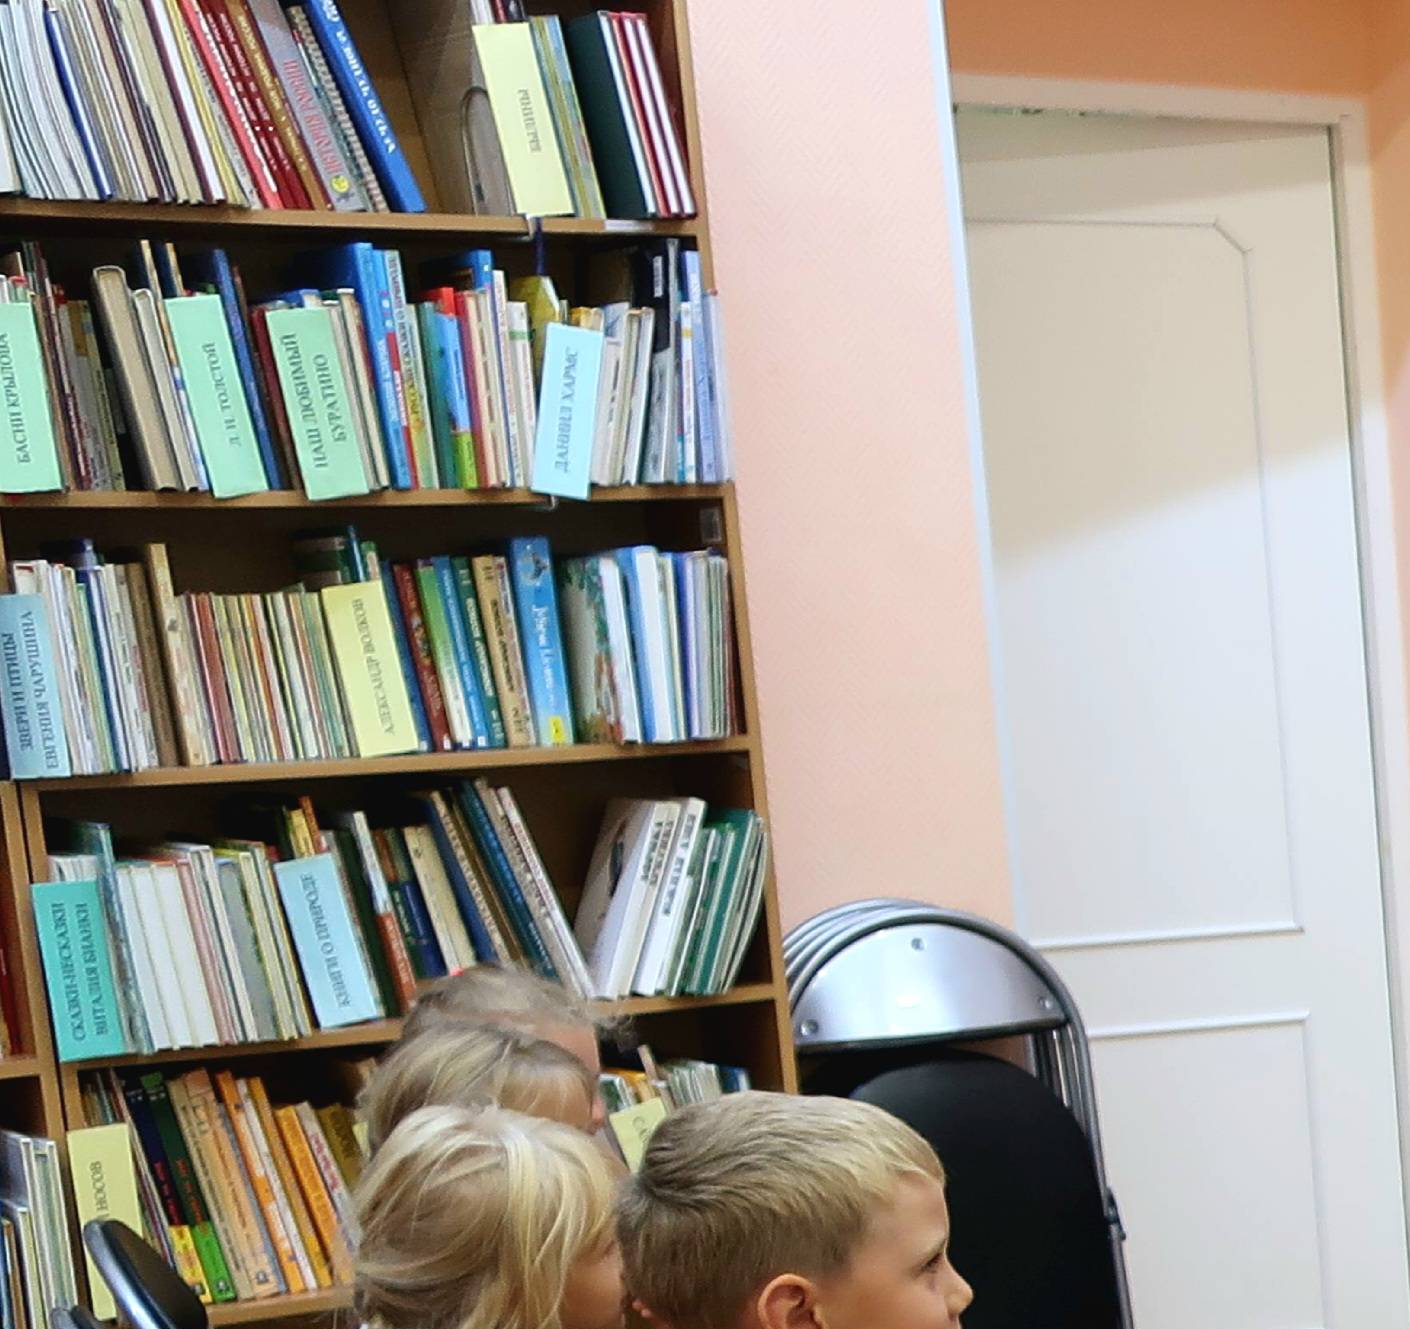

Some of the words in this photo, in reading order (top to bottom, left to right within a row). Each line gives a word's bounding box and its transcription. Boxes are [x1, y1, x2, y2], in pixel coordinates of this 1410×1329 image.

[517, 89, 542, 152] БЫЛИНЫ
[202, 342, 232, 415] ТОЛСТОЙ
[281, 333, 317, 425] ЛЮБИМЫЙ
[313, 353, 347, 443] БУРАТИНО
[563, 346, 579, 402] ХАРМС
[10, 412, 31, 463] БАСНИ
[308, 427, 329, 468] НАШ
[554, 405, 573, 473] ДАНИИЛ
[20, 611, 47, 698] ЧАРУШИНА
[353, 598, 375, 655] ВОЛКОВ
[2, 633, 23, 687] ПТИЦЫ
[11, 691, 25, 702] И
[366, 655, 396, 736] АЛЕКСАНДР
[14, 705, 33, 751] ЗВЕРИ
[36, 702, 59, 769] ЕВГЕНИЯ
[76, 903, 97, 964] БИАНКИ
[301, 872, 330, 940] ПРИРОДЕ
[52, 902, 86, 1042] СКАЗКИ-НЕСКАЗКИ
[320, 942, 334, 955] О
[85, 967, 108, 1036] ВИТАЛИЯ
[325, 957, 350, 1008] КНИГИ
[88, 1160, 110, 1211] НОСОВ
